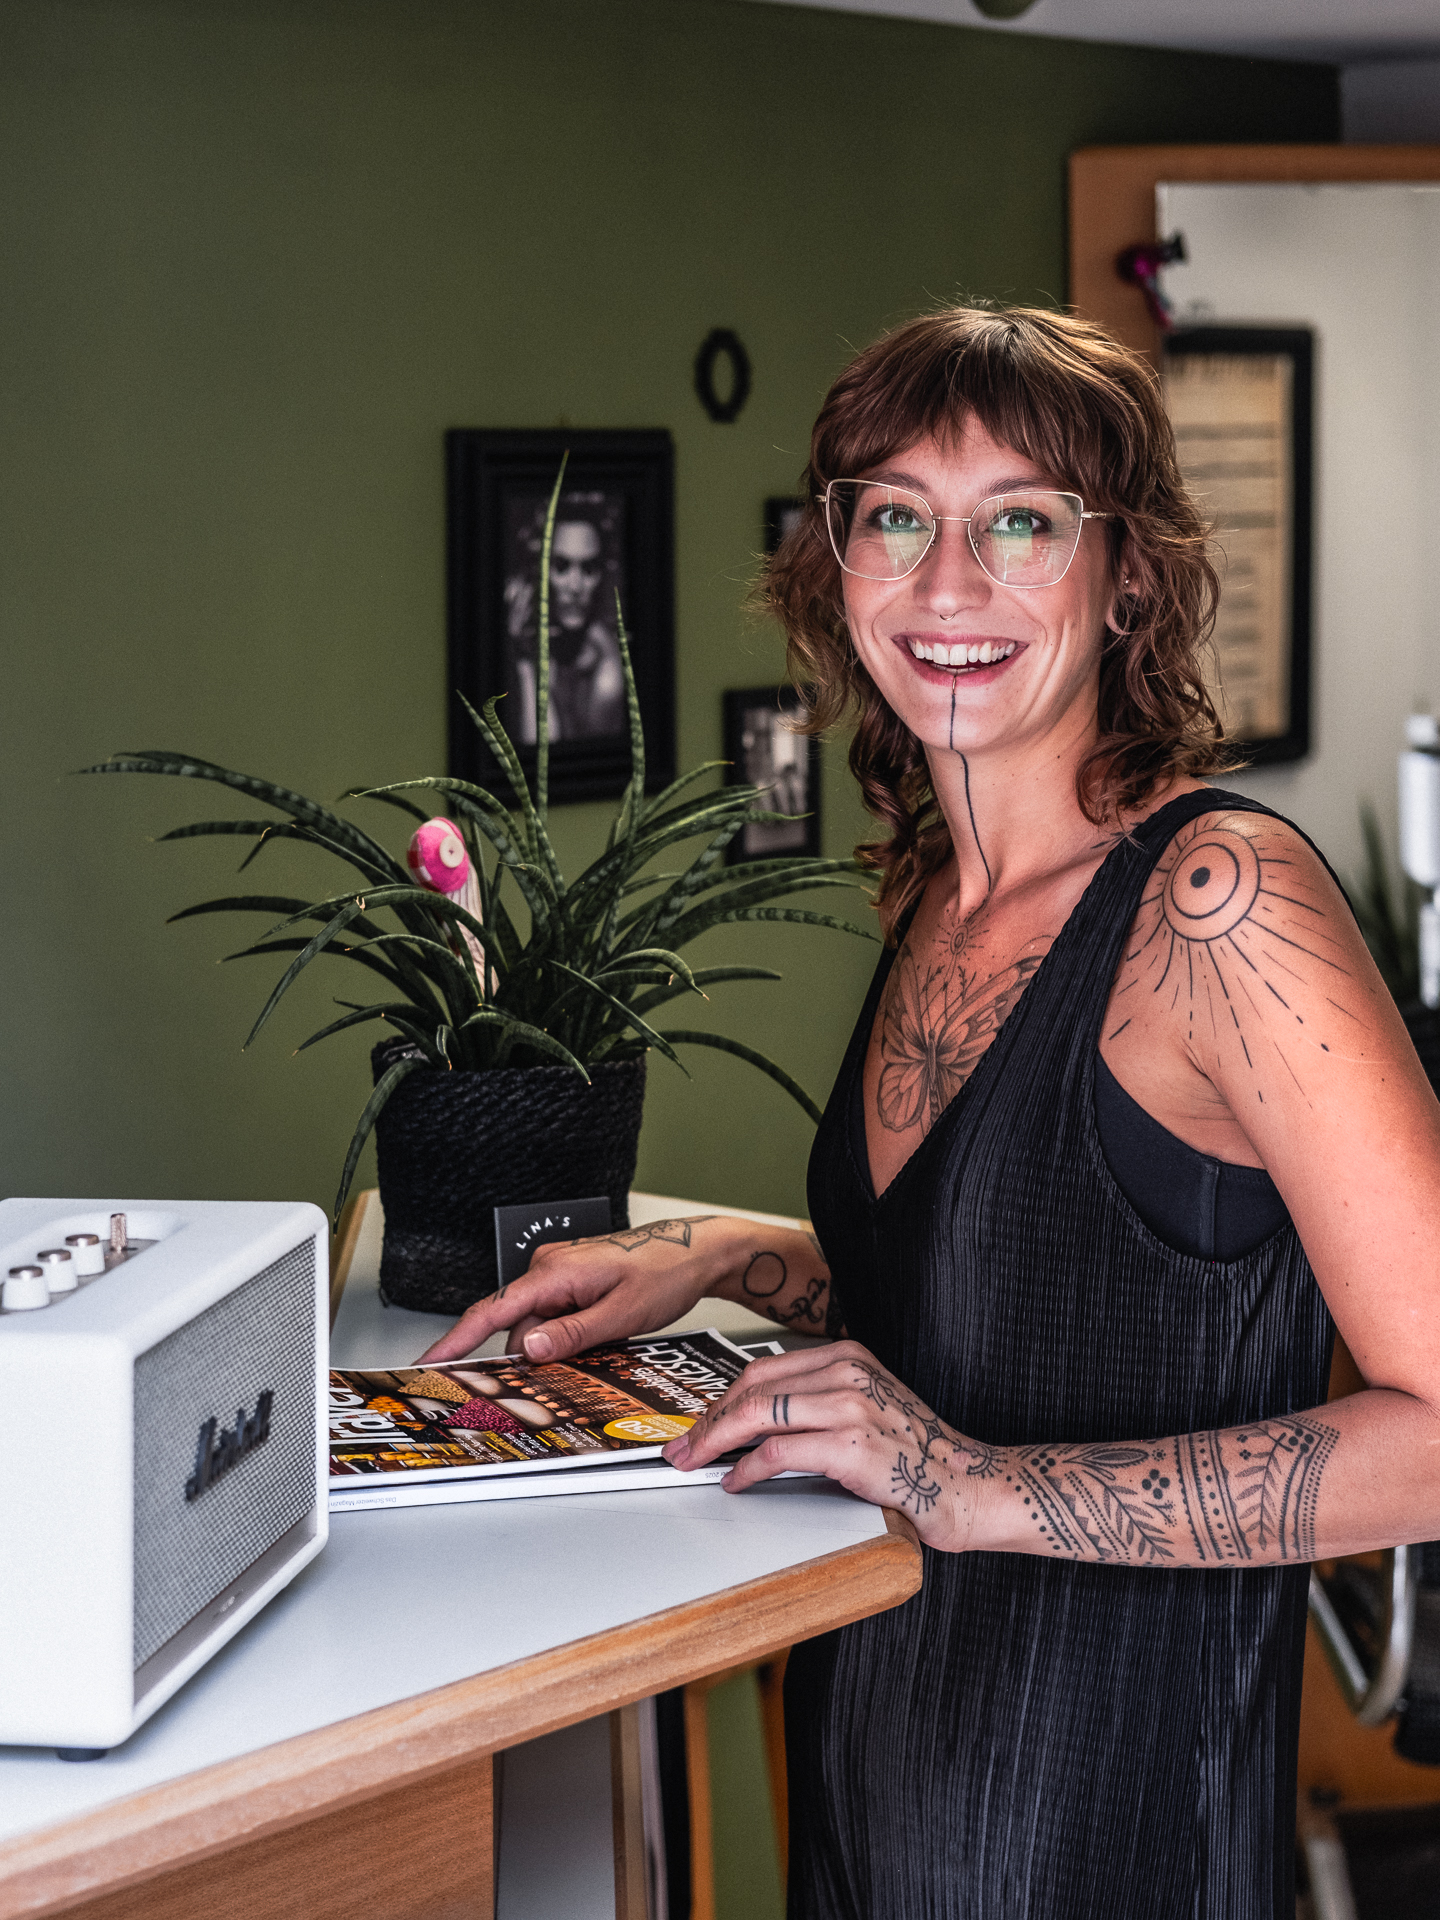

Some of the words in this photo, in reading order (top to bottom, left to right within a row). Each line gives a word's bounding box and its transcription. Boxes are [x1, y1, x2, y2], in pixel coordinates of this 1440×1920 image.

[515, 1216, 571, 1250] LINA'S
[630, 1367, 708, 1414] Märchenhaftes
[614, 1420, 675, 1439] A350
